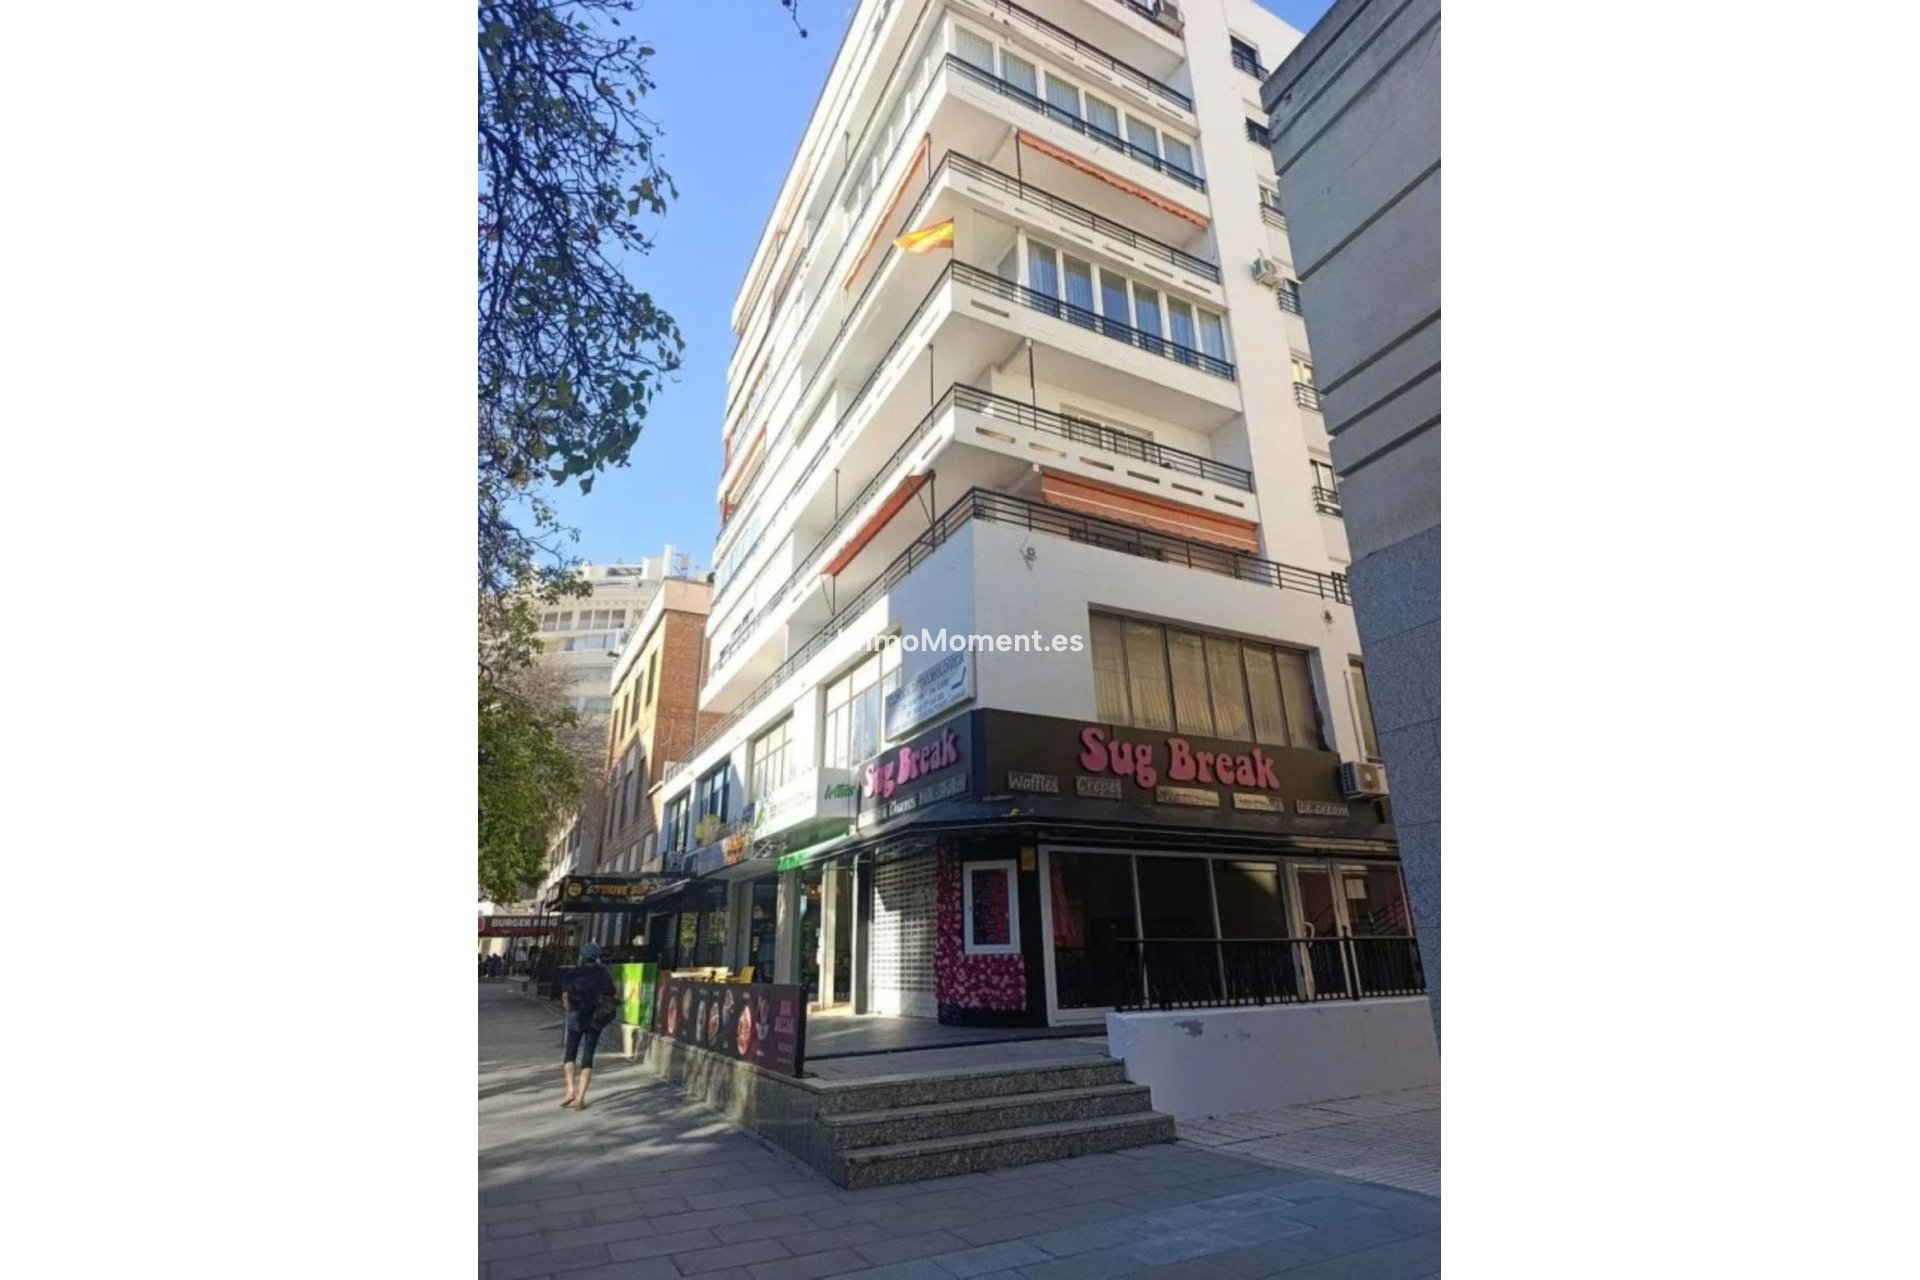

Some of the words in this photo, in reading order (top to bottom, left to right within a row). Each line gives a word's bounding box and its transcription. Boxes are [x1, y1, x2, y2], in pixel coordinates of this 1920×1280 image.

[863, 761, 894, 799] Sug
[896, 727, 957, 785] Break
[1079, 726, 1158, 789] Sug
[1166, 736, 1281, 789] Break
[1008, 773, 1058, 793] Waffles
[491, 918, 531, 928] BURGER
